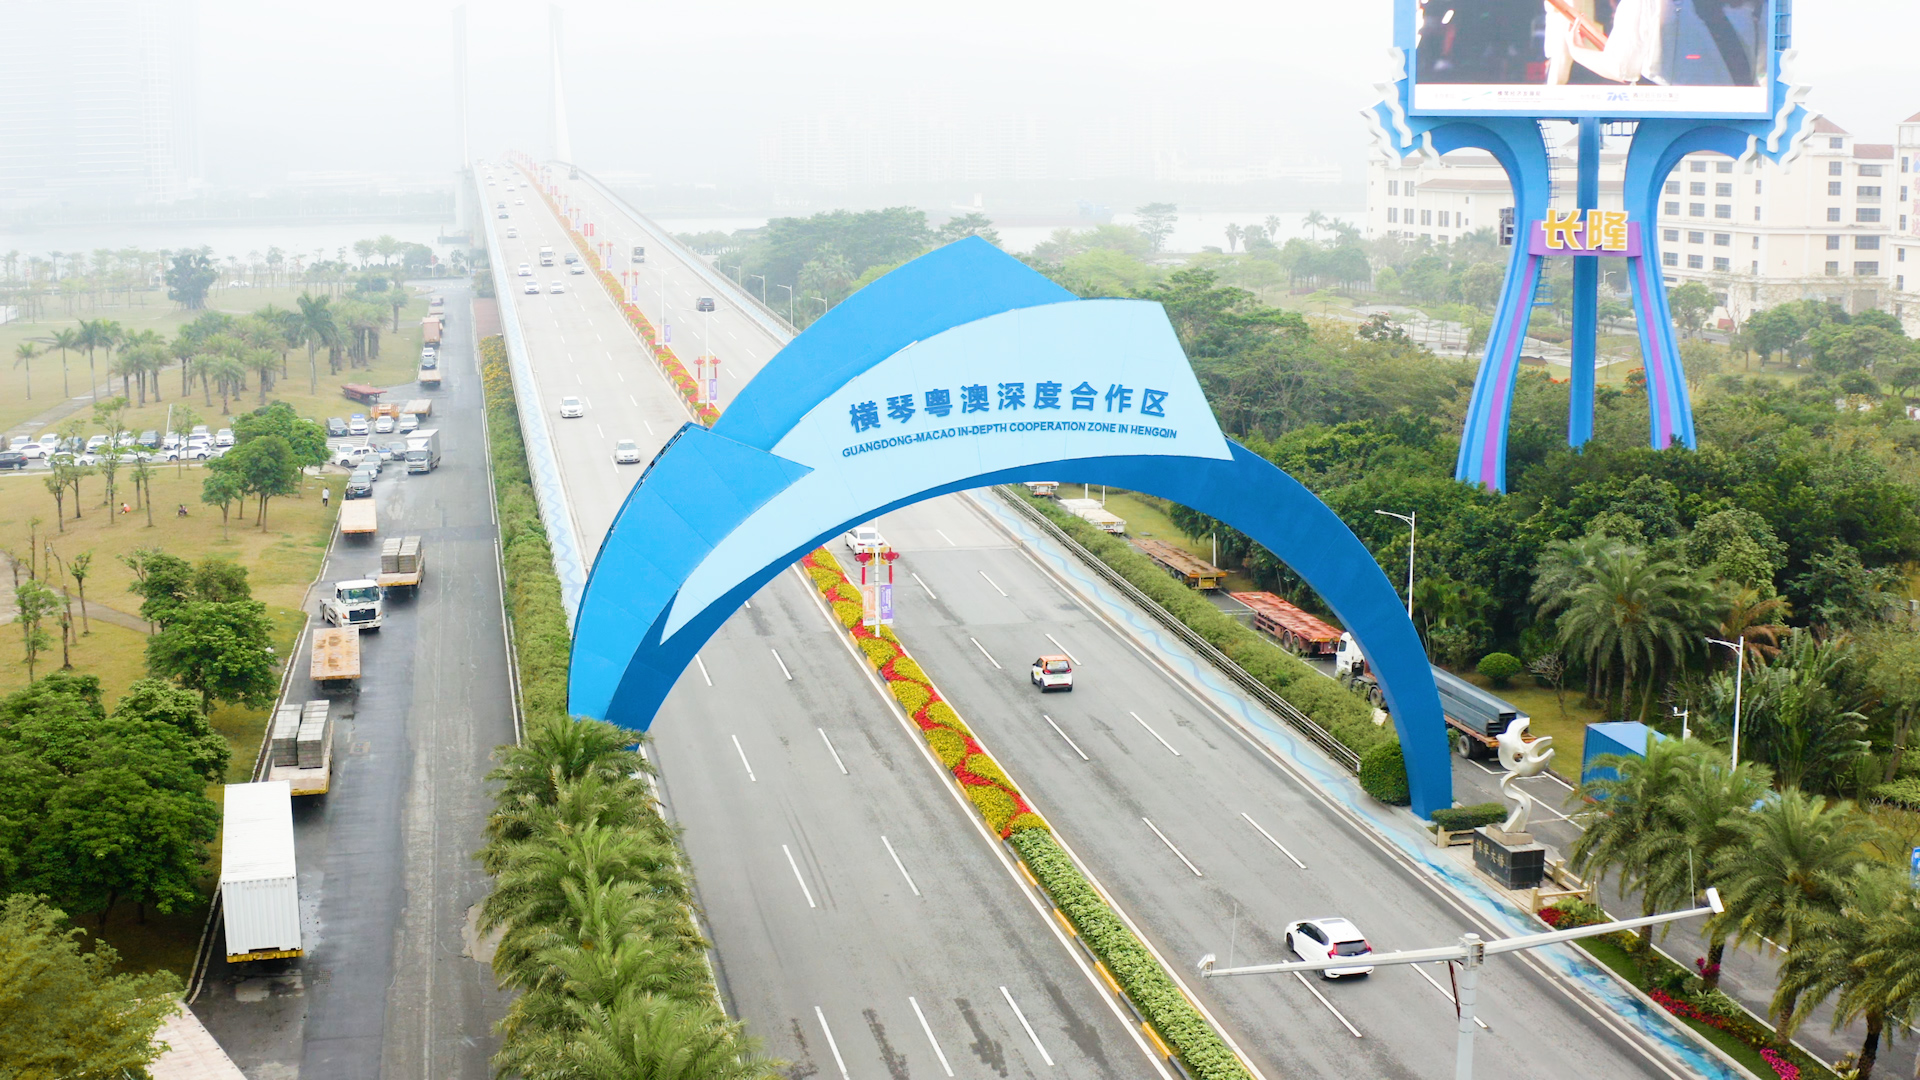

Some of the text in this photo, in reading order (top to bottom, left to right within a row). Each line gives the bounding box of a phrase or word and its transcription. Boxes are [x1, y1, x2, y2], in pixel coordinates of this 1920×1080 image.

[1541, 208, 1629, 251] 长隆
[849, 380, 1169, 433] 横琴粤澳深度合作区
[842, 421, 1178, 457] GUANGDONG-MACAO IN-DEPTH COOPERATION ZONE IN HENGQIN
